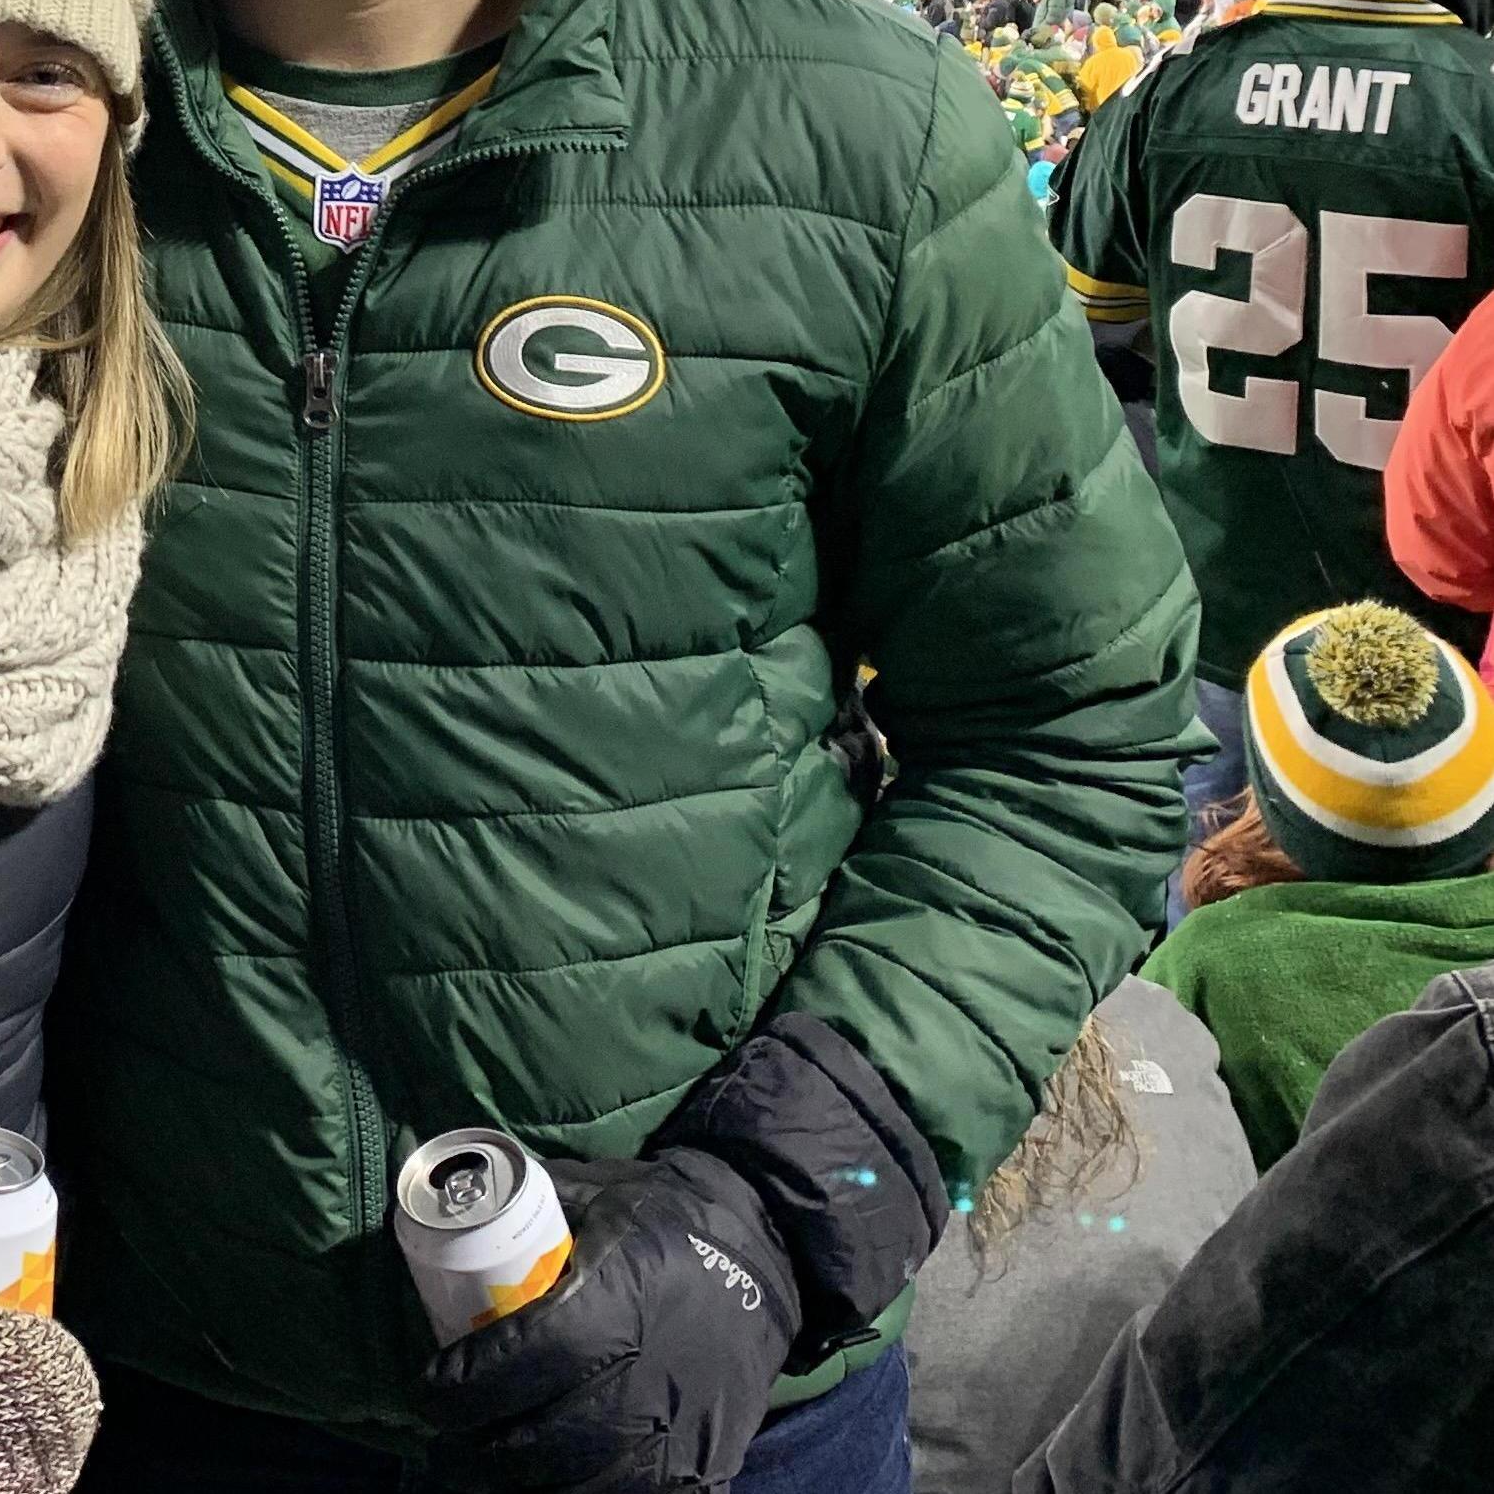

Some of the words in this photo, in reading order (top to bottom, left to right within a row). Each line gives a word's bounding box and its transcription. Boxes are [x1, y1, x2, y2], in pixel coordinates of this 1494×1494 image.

[1236, 62, 1411, 135] GRANT
[323, 202, 373, 242] NFL
[487, 306, 651, 409] G
[1170, 192, 1469, 473] 25
